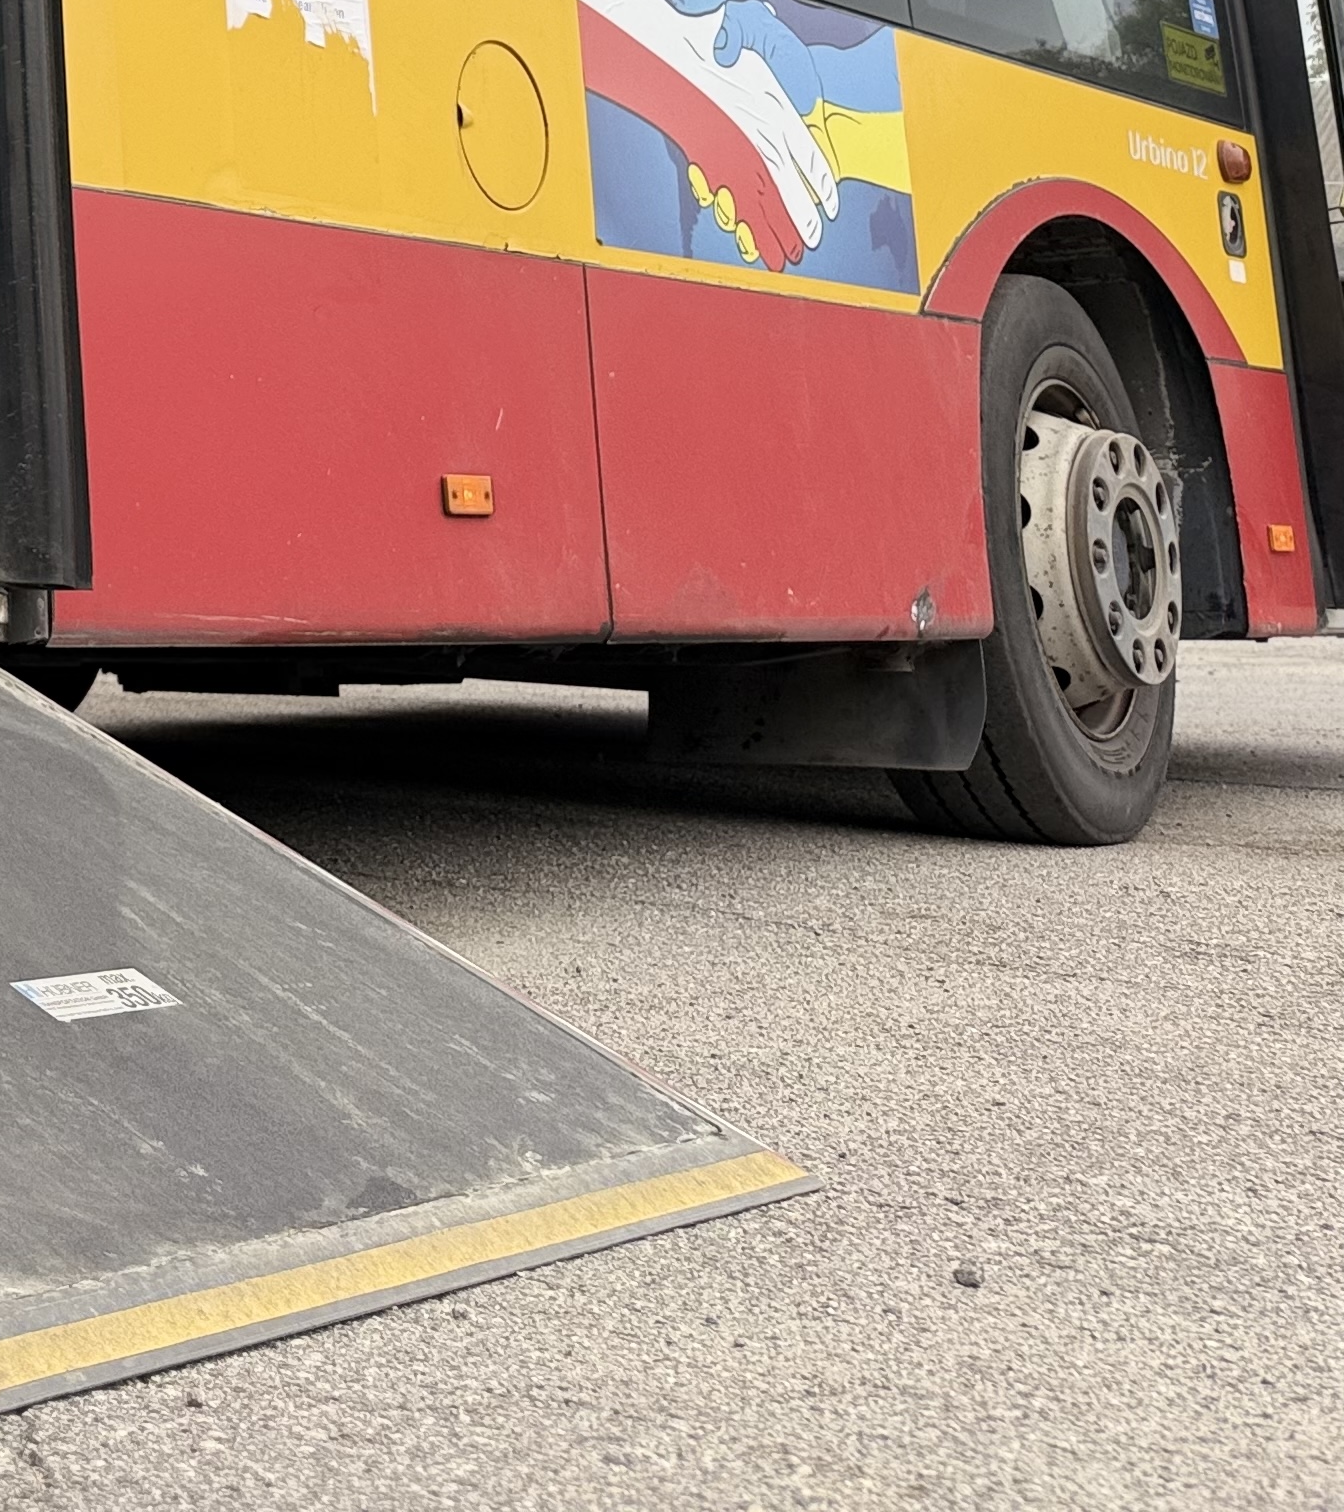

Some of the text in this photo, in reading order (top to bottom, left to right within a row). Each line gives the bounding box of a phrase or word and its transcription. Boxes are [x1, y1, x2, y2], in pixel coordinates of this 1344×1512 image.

[1128, 130, 1208, 180] Urbino 12
[106, 985, 162, 1008] 350
